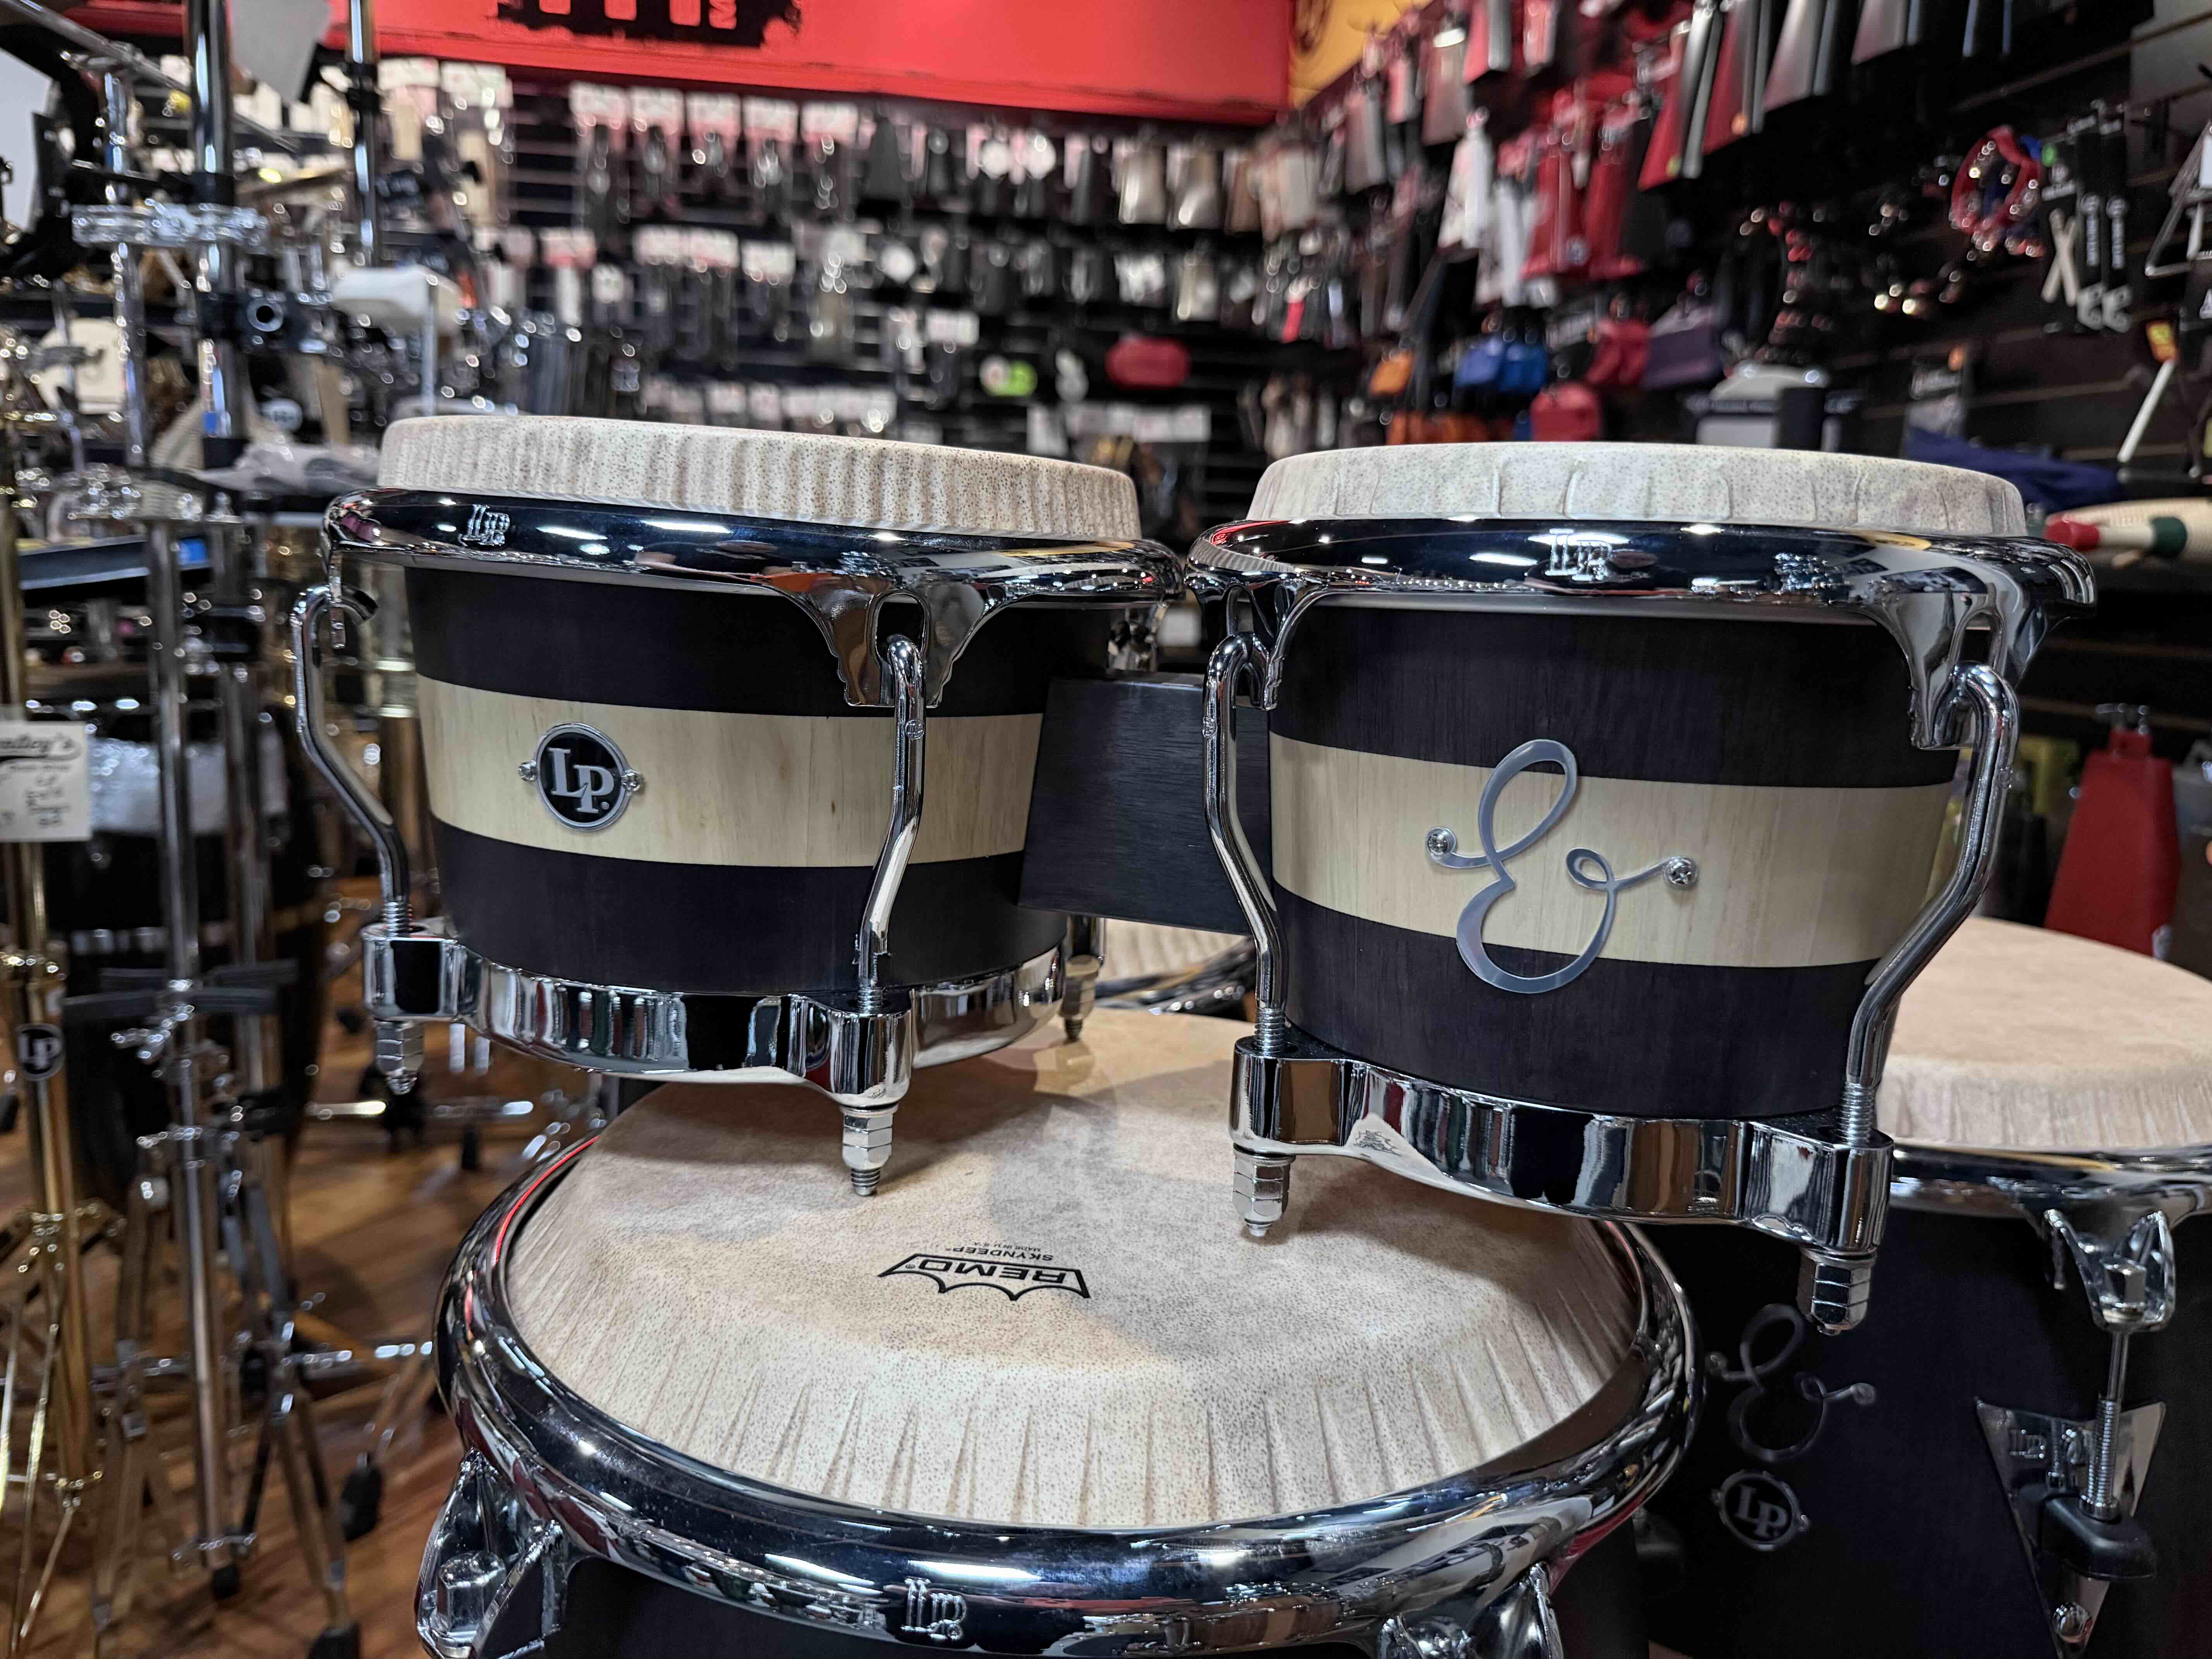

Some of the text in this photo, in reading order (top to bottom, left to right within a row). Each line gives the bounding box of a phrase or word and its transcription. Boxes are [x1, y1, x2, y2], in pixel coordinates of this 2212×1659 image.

[546, 747, 615, 813] LP
[19, 1033, 62, 1068] LP
[918, 1258, 1066, 1284] REMO
[953, 1247, 1054, 1261] SKYNDEEP
[1736, 1484, 1788, 1537] LP
